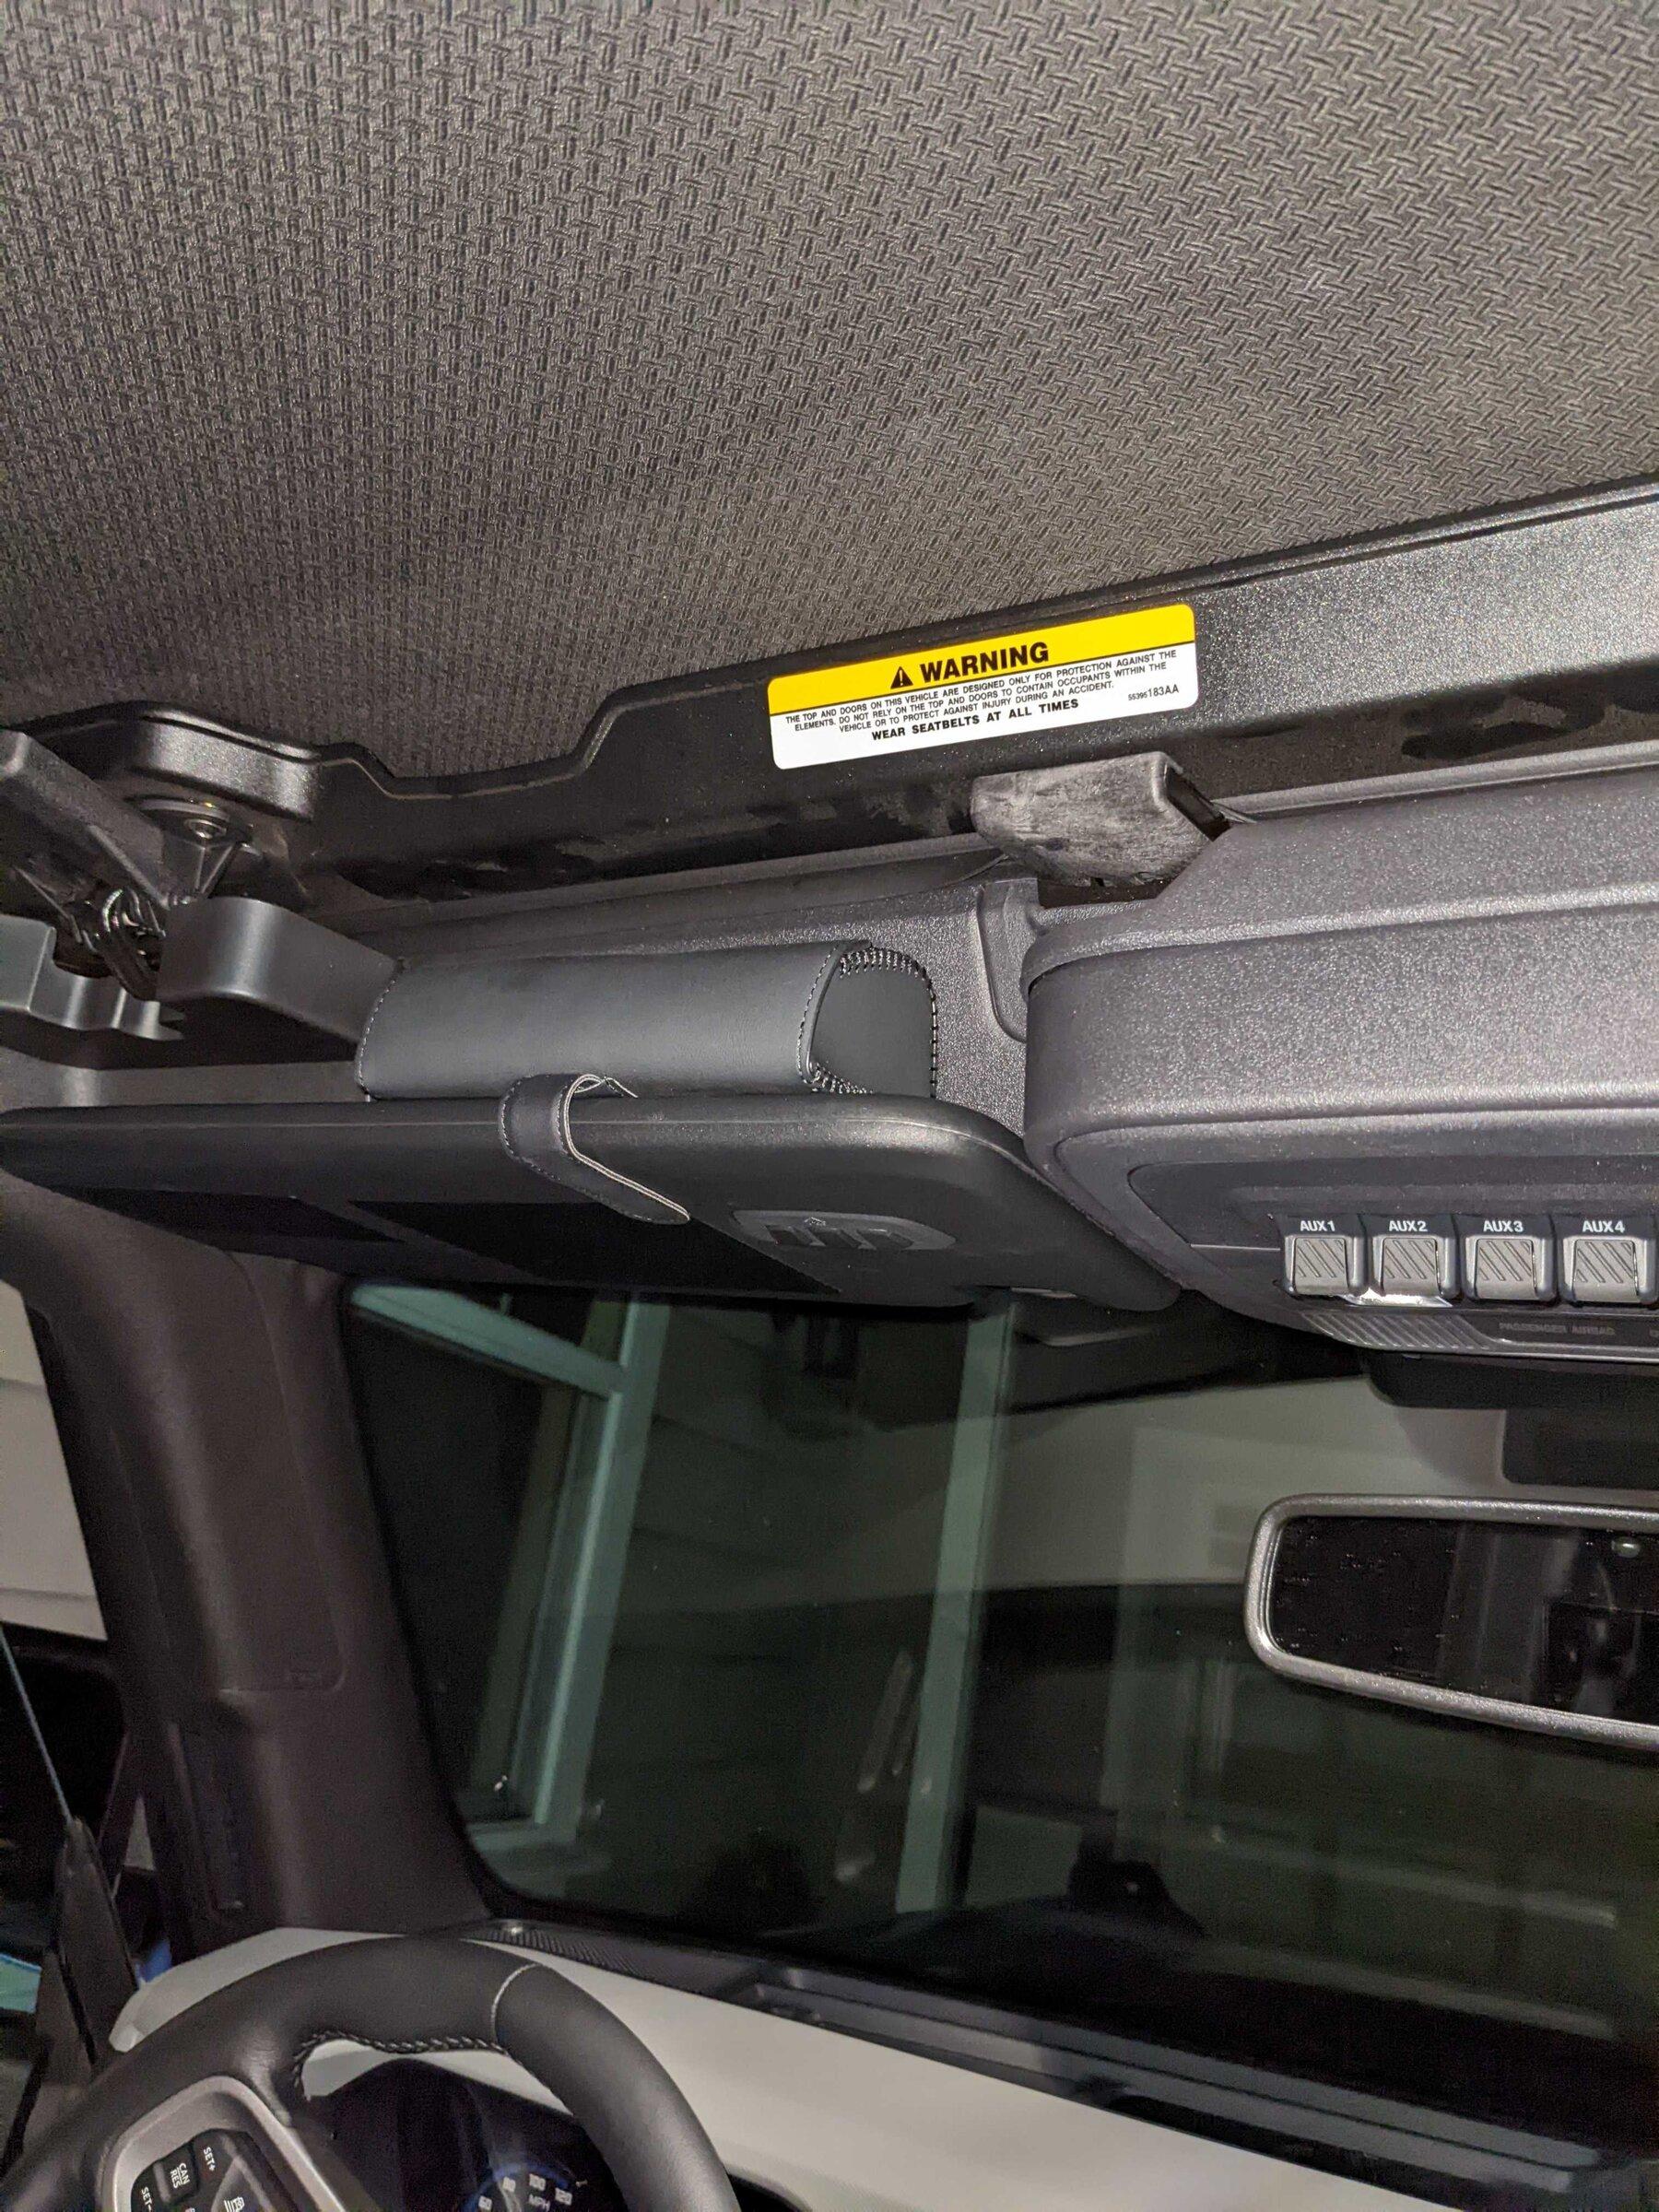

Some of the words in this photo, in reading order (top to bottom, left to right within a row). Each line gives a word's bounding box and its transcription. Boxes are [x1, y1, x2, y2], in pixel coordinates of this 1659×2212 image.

[920, 641, 1049, 683] WARNING
[785, 715, 801, 724] THE
[803, 712, 818, 723] TOP
[820, 710, 837, 719] AND
[841, 704, 867, 715] DOORS
[871, 700, 882, 710] ON
[885, 698, 902, 707] THIS
[905, 691, 938, 704] VEHICLE
[943, 688, 959, 698] ARE
[963, 679, 1005, 693] DESIGNED
[1008, 675, 1030, 686] ONLY
[1034, 673, 1053, 682] FOR
[1056, 662, 1112, 677] PROTECTION
[1116, 653, 1156, 667] AGAINST
[1159, 650, 1177, 660] THE
[794, 719, 837, 732] ELEMENTS.
[839, 715, 851, 724] DO
[853, 712, 869, 722] NOT
[872, 708, 892, 719] RELY
[896, 706, 907, 715] ON
[911, 702, 925, 712] THE
[929, 700, 944, 710] TOP
[947, 697, 964, 706] AND
[969, 691, 998, 702] DOORS
[1002, 688, 1012, 697] TO
[1016, 681, 1053, 695] CONTAIN
[1057, 671, 1111, 687] OCCUPANTS
[1114, 666, 1146, 678] WITHIN
[1149, 662, 1167, 671] THE
[839, 721, 872, 734] VEHICLE
[876, 719, 887, 727] OR
[889, 715, 900, 724] TO
[903, 710, 940, 723] PROTECT
[944, 704, 979, 717] AGAINST
[982, 697, 1011, 710] INJURY
[1016, 691, 1049, 704] DURING
[1052, 688, 1065, 698] AN
[1068, 681, 1113, 695] ACCIDENT.
[872, 726, 905, 741] WEAR
[912, 714, 980, 735] SEATBELTS
[986, 712, 1001, 723] AT
[1008, 706, 1032, 719] ALL
[1038, 699, 1078, 714] TIMES
[1300, 1219, 1336, 1233] AUX1
[1388, 1219, 1428, 1233] AUX2
[1483, 1219, 1524, 1233] AUX3
[1582, 1219, 1626, 1234] AUX4
[203, 2147, 216, 2171] SET+
[170, 2169, 181, 2189] RES
[179, 2162, 190, 2185] CAN
